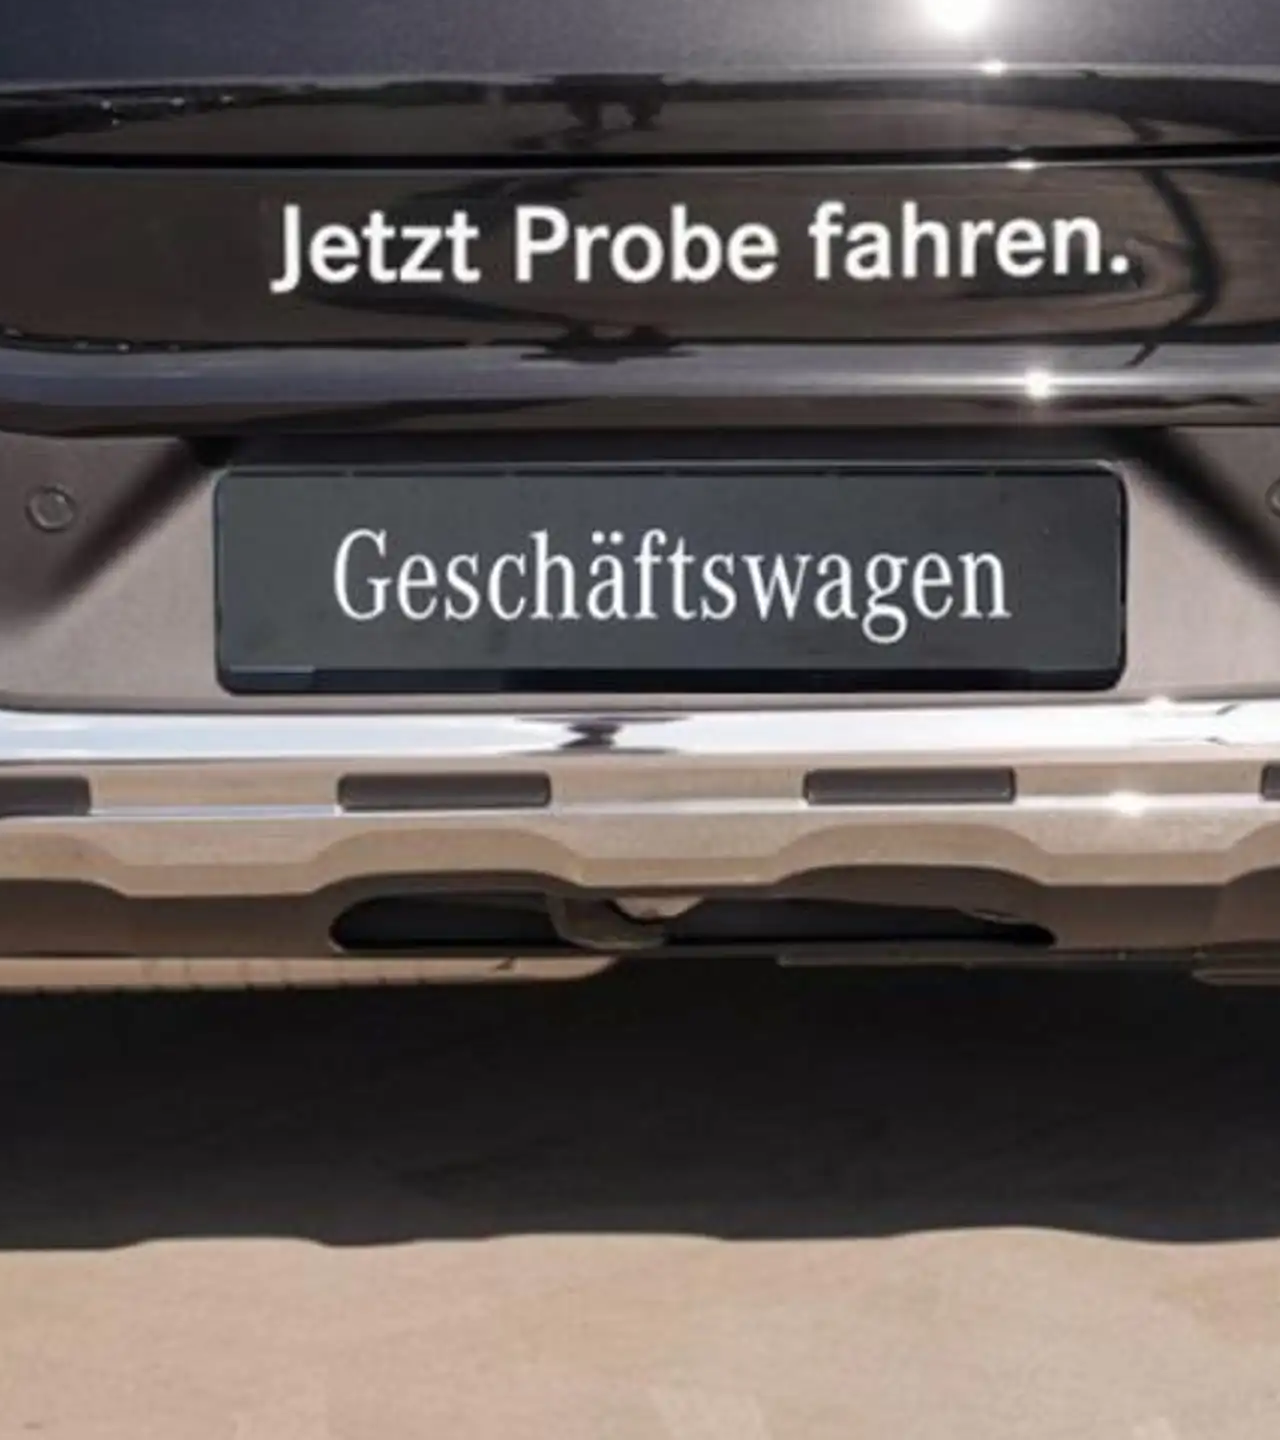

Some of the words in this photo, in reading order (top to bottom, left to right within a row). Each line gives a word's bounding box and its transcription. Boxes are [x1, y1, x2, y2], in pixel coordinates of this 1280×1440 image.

[270, 205, 481, 294] Jetzt
[515, 204, 780, 282] Probe
[808, 201, 1131, 280] fahren.
[332, 527, 1012, 643] Geschäftswagen
